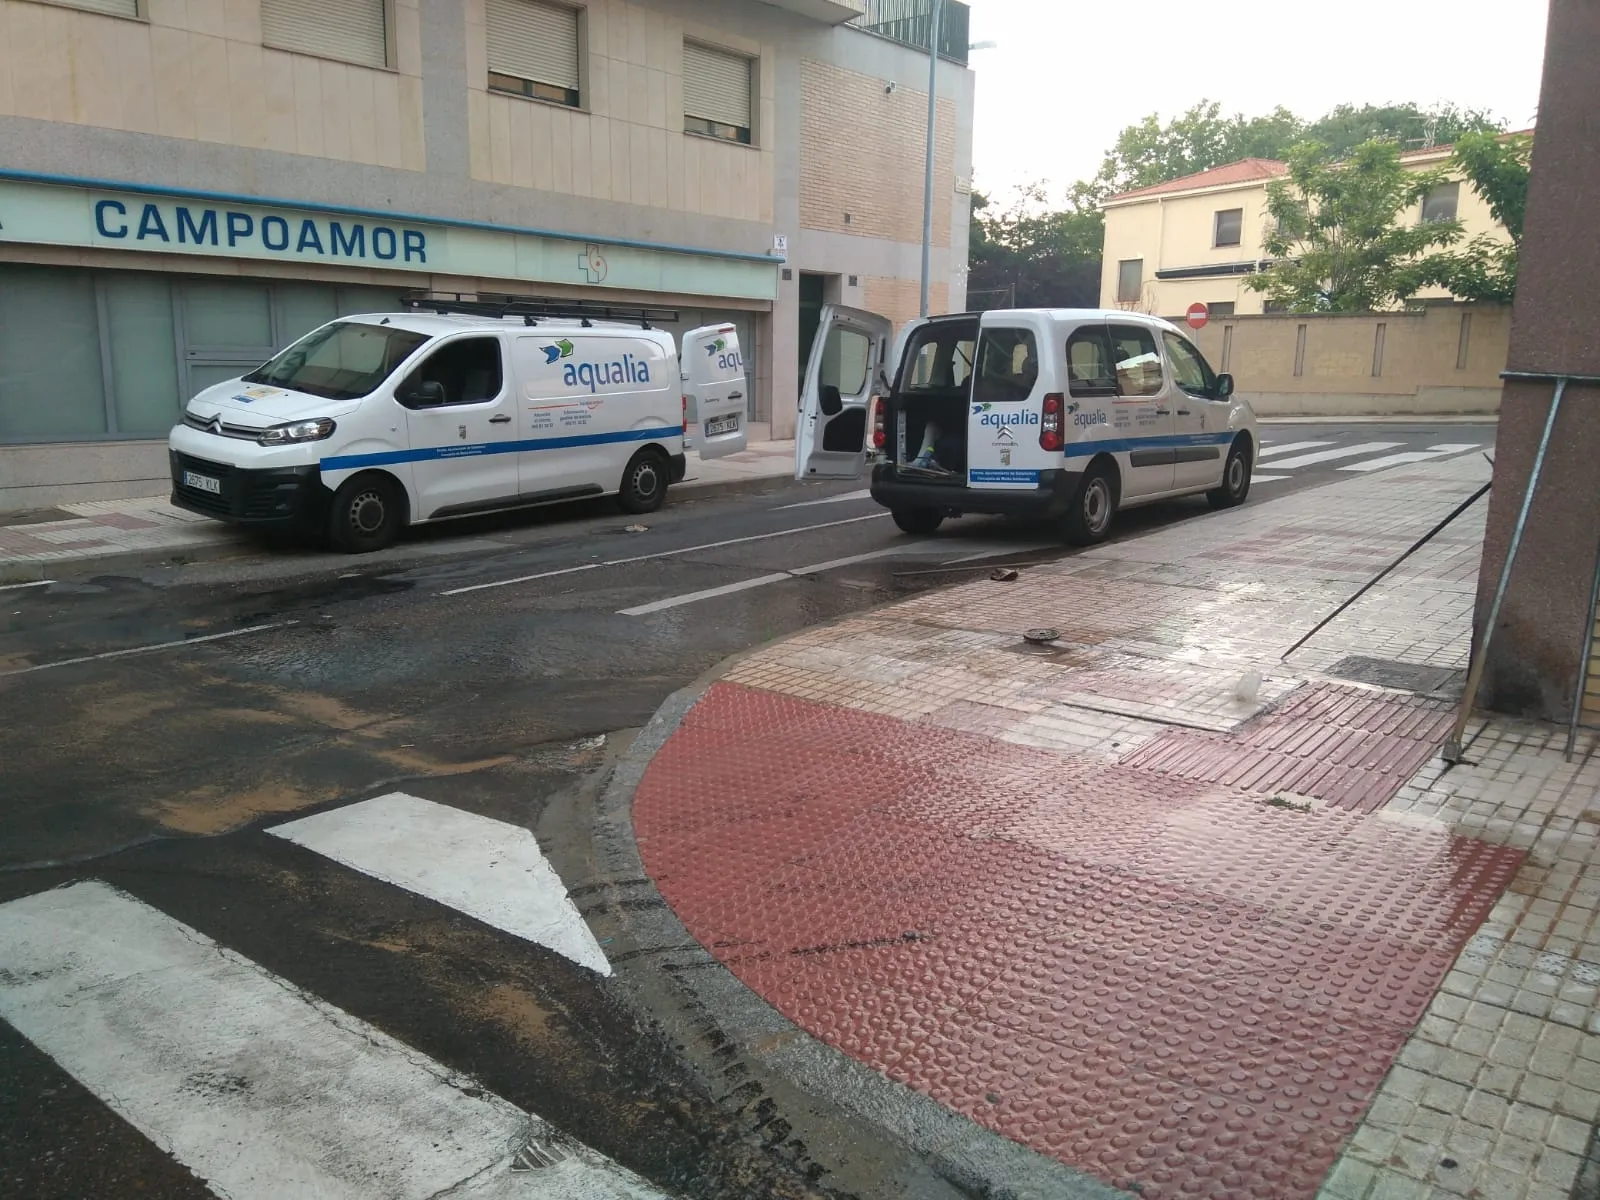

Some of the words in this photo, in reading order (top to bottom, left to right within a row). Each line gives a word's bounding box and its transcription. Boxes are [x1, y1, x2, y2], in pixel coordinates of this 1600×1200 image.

[95, 199, 427, 263] CAMPOAMOR
[563, 353, 650, 393] aqualia
[980, 409, 1039, 429] aqualia
[1074, 408, 1107, 429] aqualia
